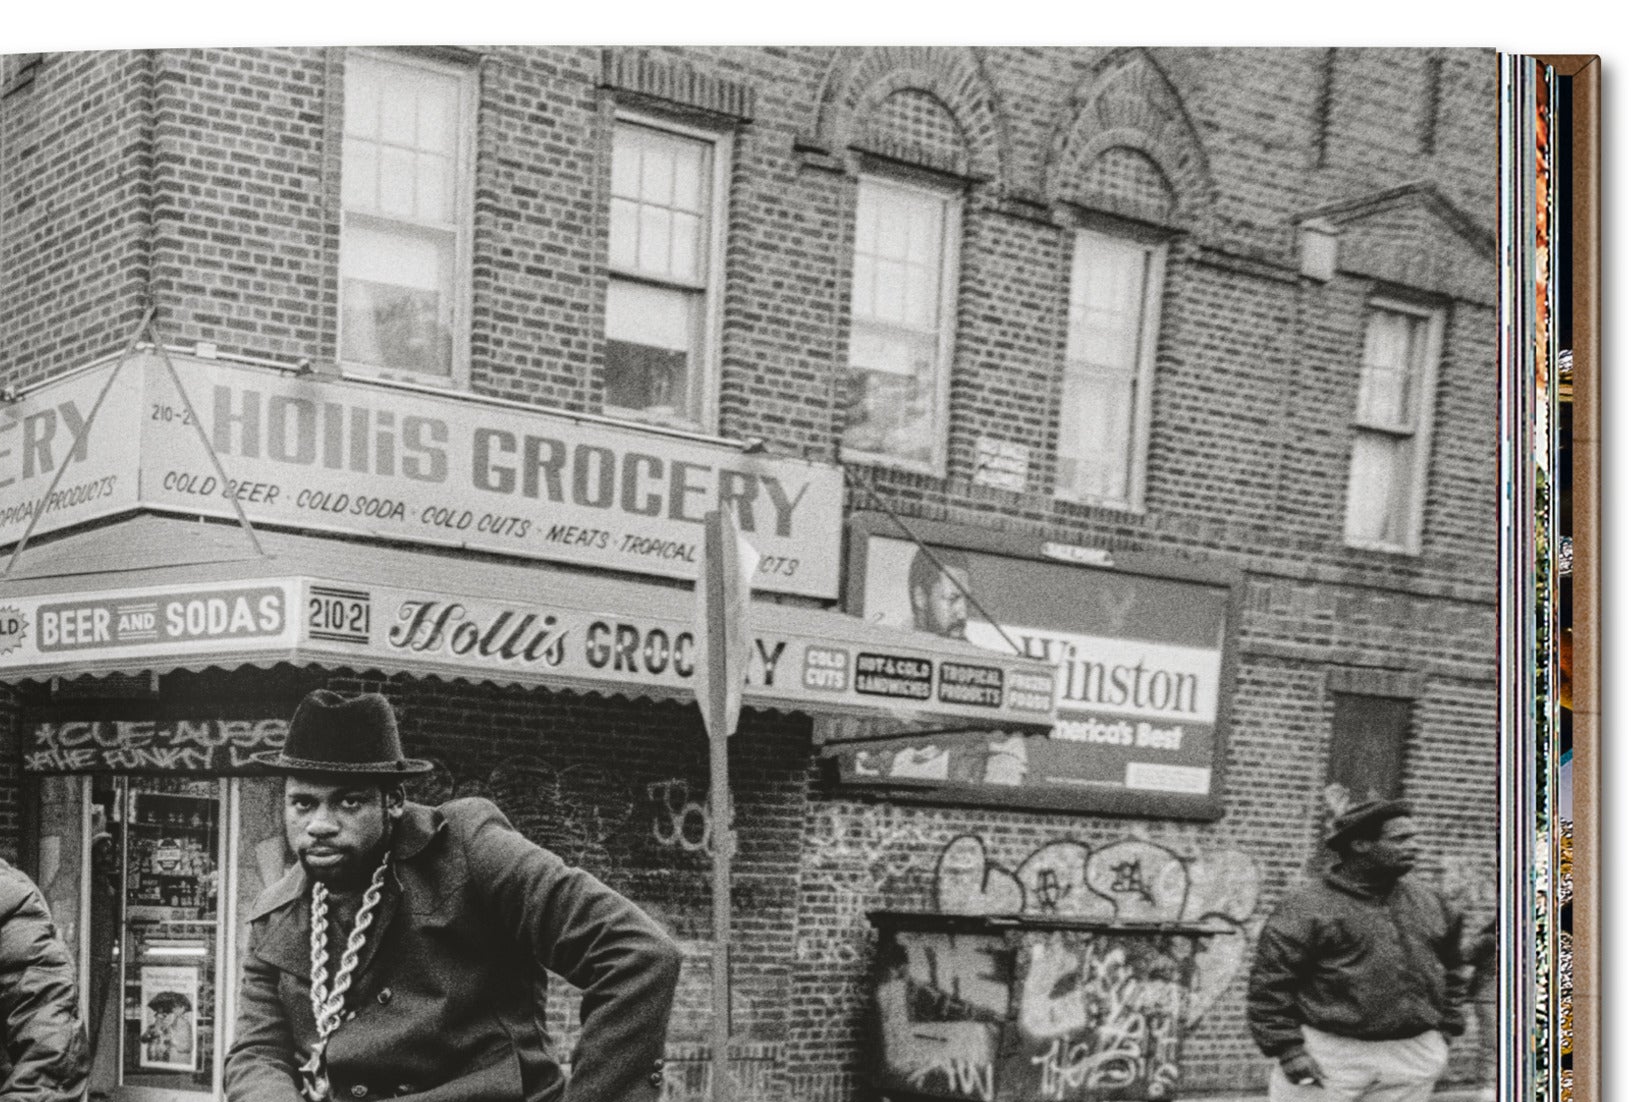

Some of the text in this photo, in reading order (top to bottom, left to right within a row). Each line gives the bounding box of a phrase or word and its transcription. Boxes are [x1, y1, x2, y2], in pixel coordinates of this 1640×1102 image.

[46, 475, 117, 514] PRODUCTS
[472, 426, 810, 538] GROCERY
[163, 471, 697, 562] COLD BEER COLD SODA COLD CUTS MEATS TROPICAL
[43, 594, 283, 646] BEER AND SODAS
[389, 599, 787, 686] Hollis GROCY
[808, 650, 845, 669] COLD
[896, 659, 930, 678] COLD
[943, 663, 1001, 686] TROPICAL
[806, 667, 844, 687] CUTS
[858, 673, 930, 698] SANDWICHES
[1051, 718, 1183, 750] merica's Best
